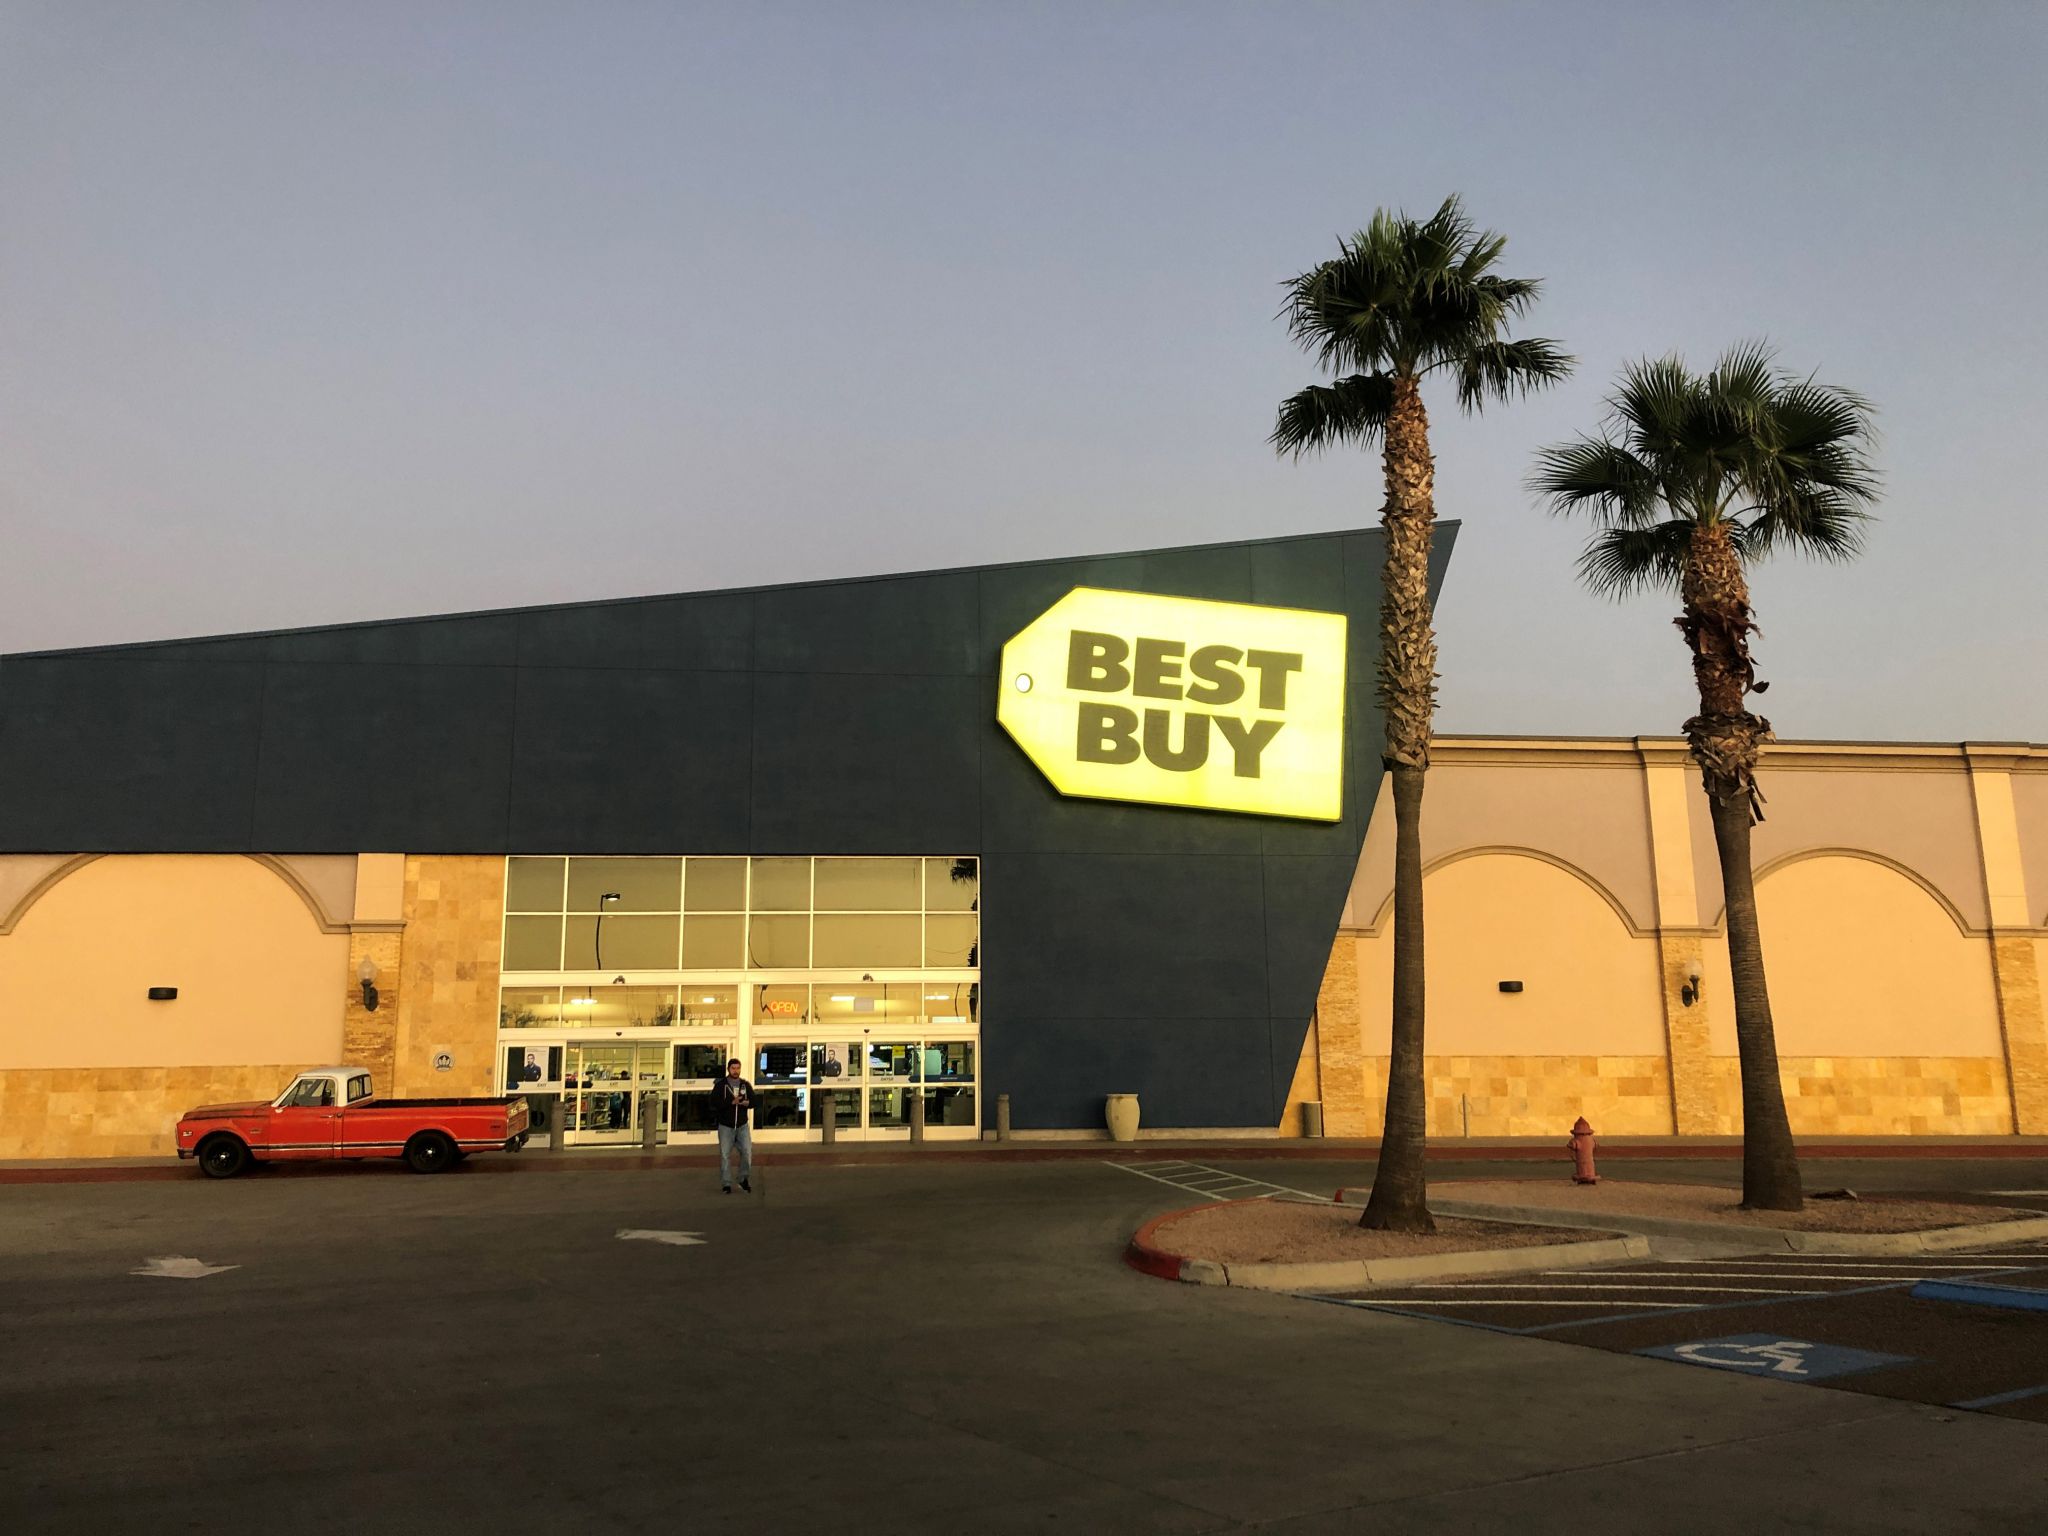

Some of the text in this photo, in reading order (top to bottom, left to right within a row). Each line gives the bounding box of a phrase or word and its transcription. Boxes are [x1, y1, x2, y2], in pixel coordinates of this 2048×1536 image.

[1066, 629, 1303, 711] BEST
[1076, 701, 1286, 779] BUY
[770, 1001, 799, 1013] OPEN
